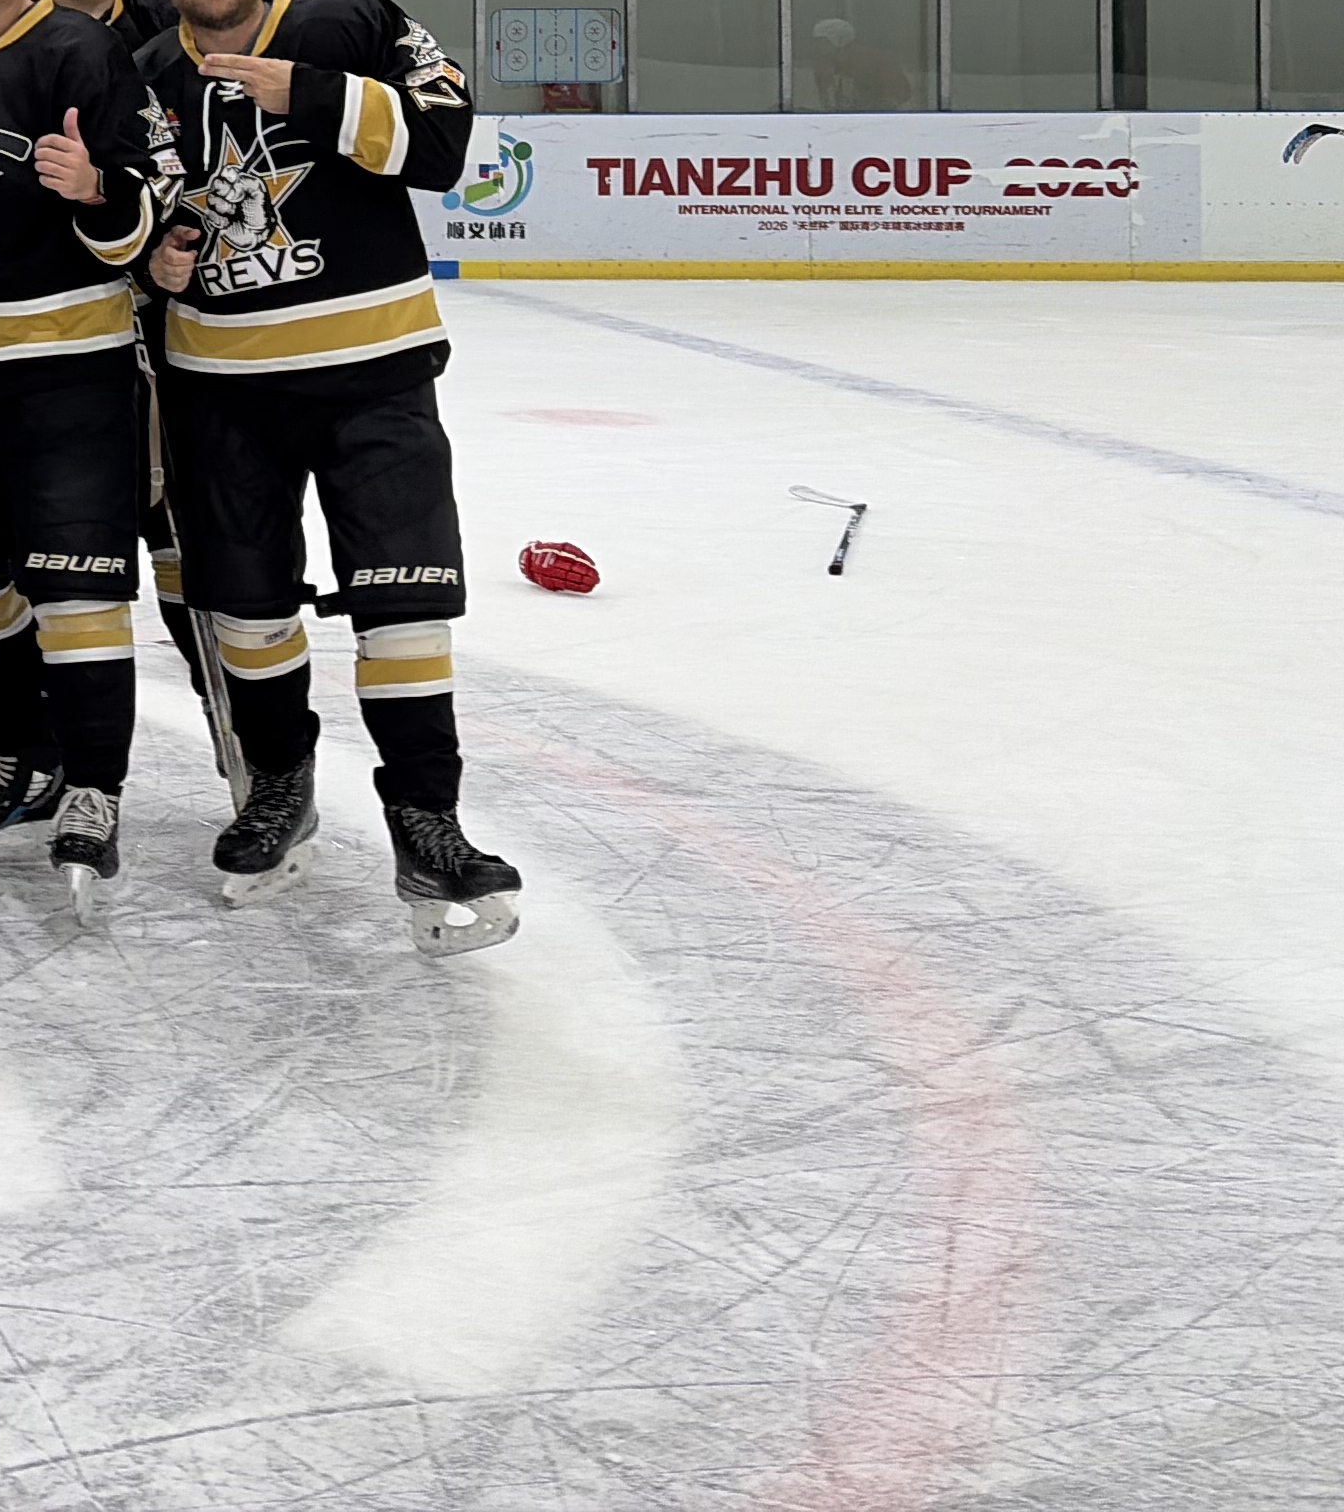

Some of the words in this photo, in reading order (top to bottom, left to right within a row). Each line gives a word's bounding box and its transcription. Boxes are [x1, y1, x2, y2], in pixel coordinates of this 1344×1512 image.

[586, 157, 834, 197] TIANZHU
[852, 157, 973, 197] CUP
[678, 204, 789, 216] INTERNATIONAL
[791, 204, 842, 216] YOUTH
[844, 204, 884, 216] ELITE
[889, 204, 950, 216] HOCKEY
[952, 204, 1053, 216] TOURNAMENT
[446, 221, 527, 240] 顺义体育
[758, 220, 789, 231] 2026
[199, 242, 322, 294] REVS
[24, 552, 127, 575] BAUER
[349, 566, 459, 586] BAUER
